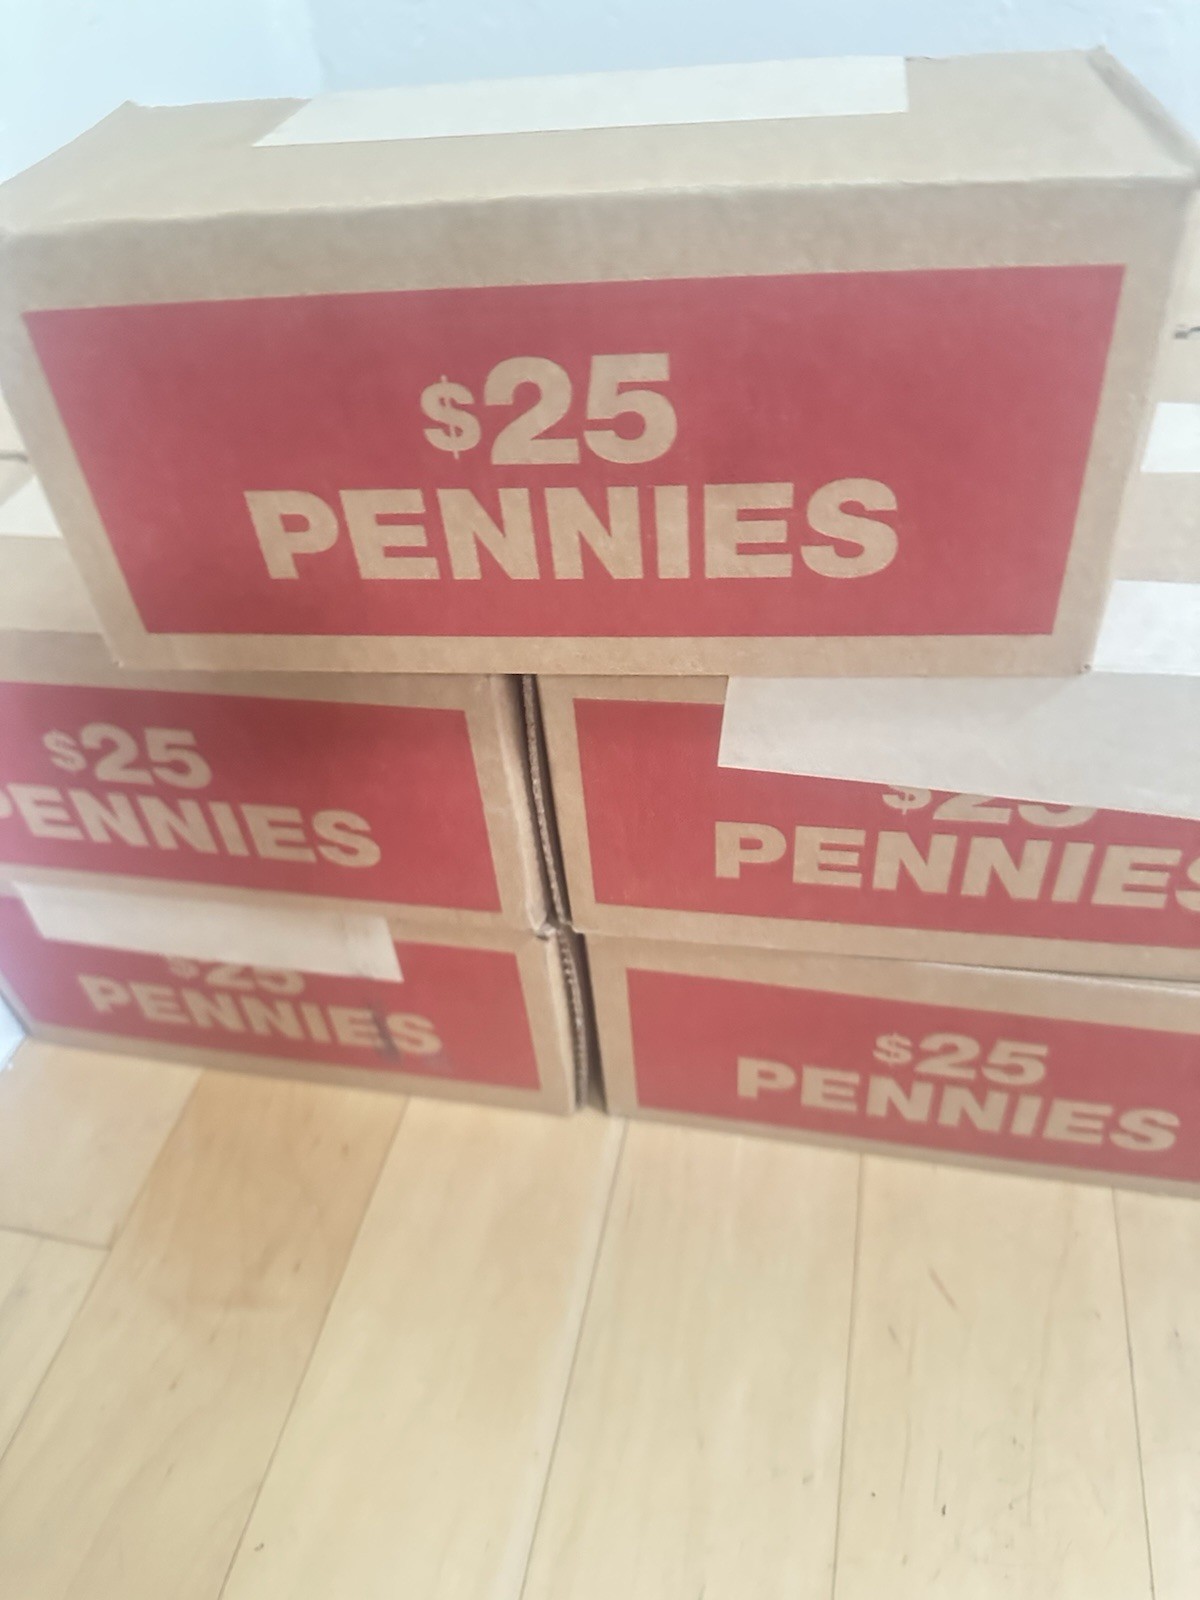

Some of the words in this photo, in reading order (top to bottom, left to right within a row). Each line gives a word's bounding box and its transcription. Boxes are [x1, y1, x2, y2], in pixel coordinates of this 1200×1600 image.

[420, 353, 678, 464] $25
[244, 478, 898, 580] PENNIES
[43, 723, 212, 789] $25
[0, 782, 381, 868] ENNIES
[78, 973, 442, 1056] PENNIES
[874, 1032, 1049, 1086] $25
[736, 1056, 1181, 1152] PENNIES
